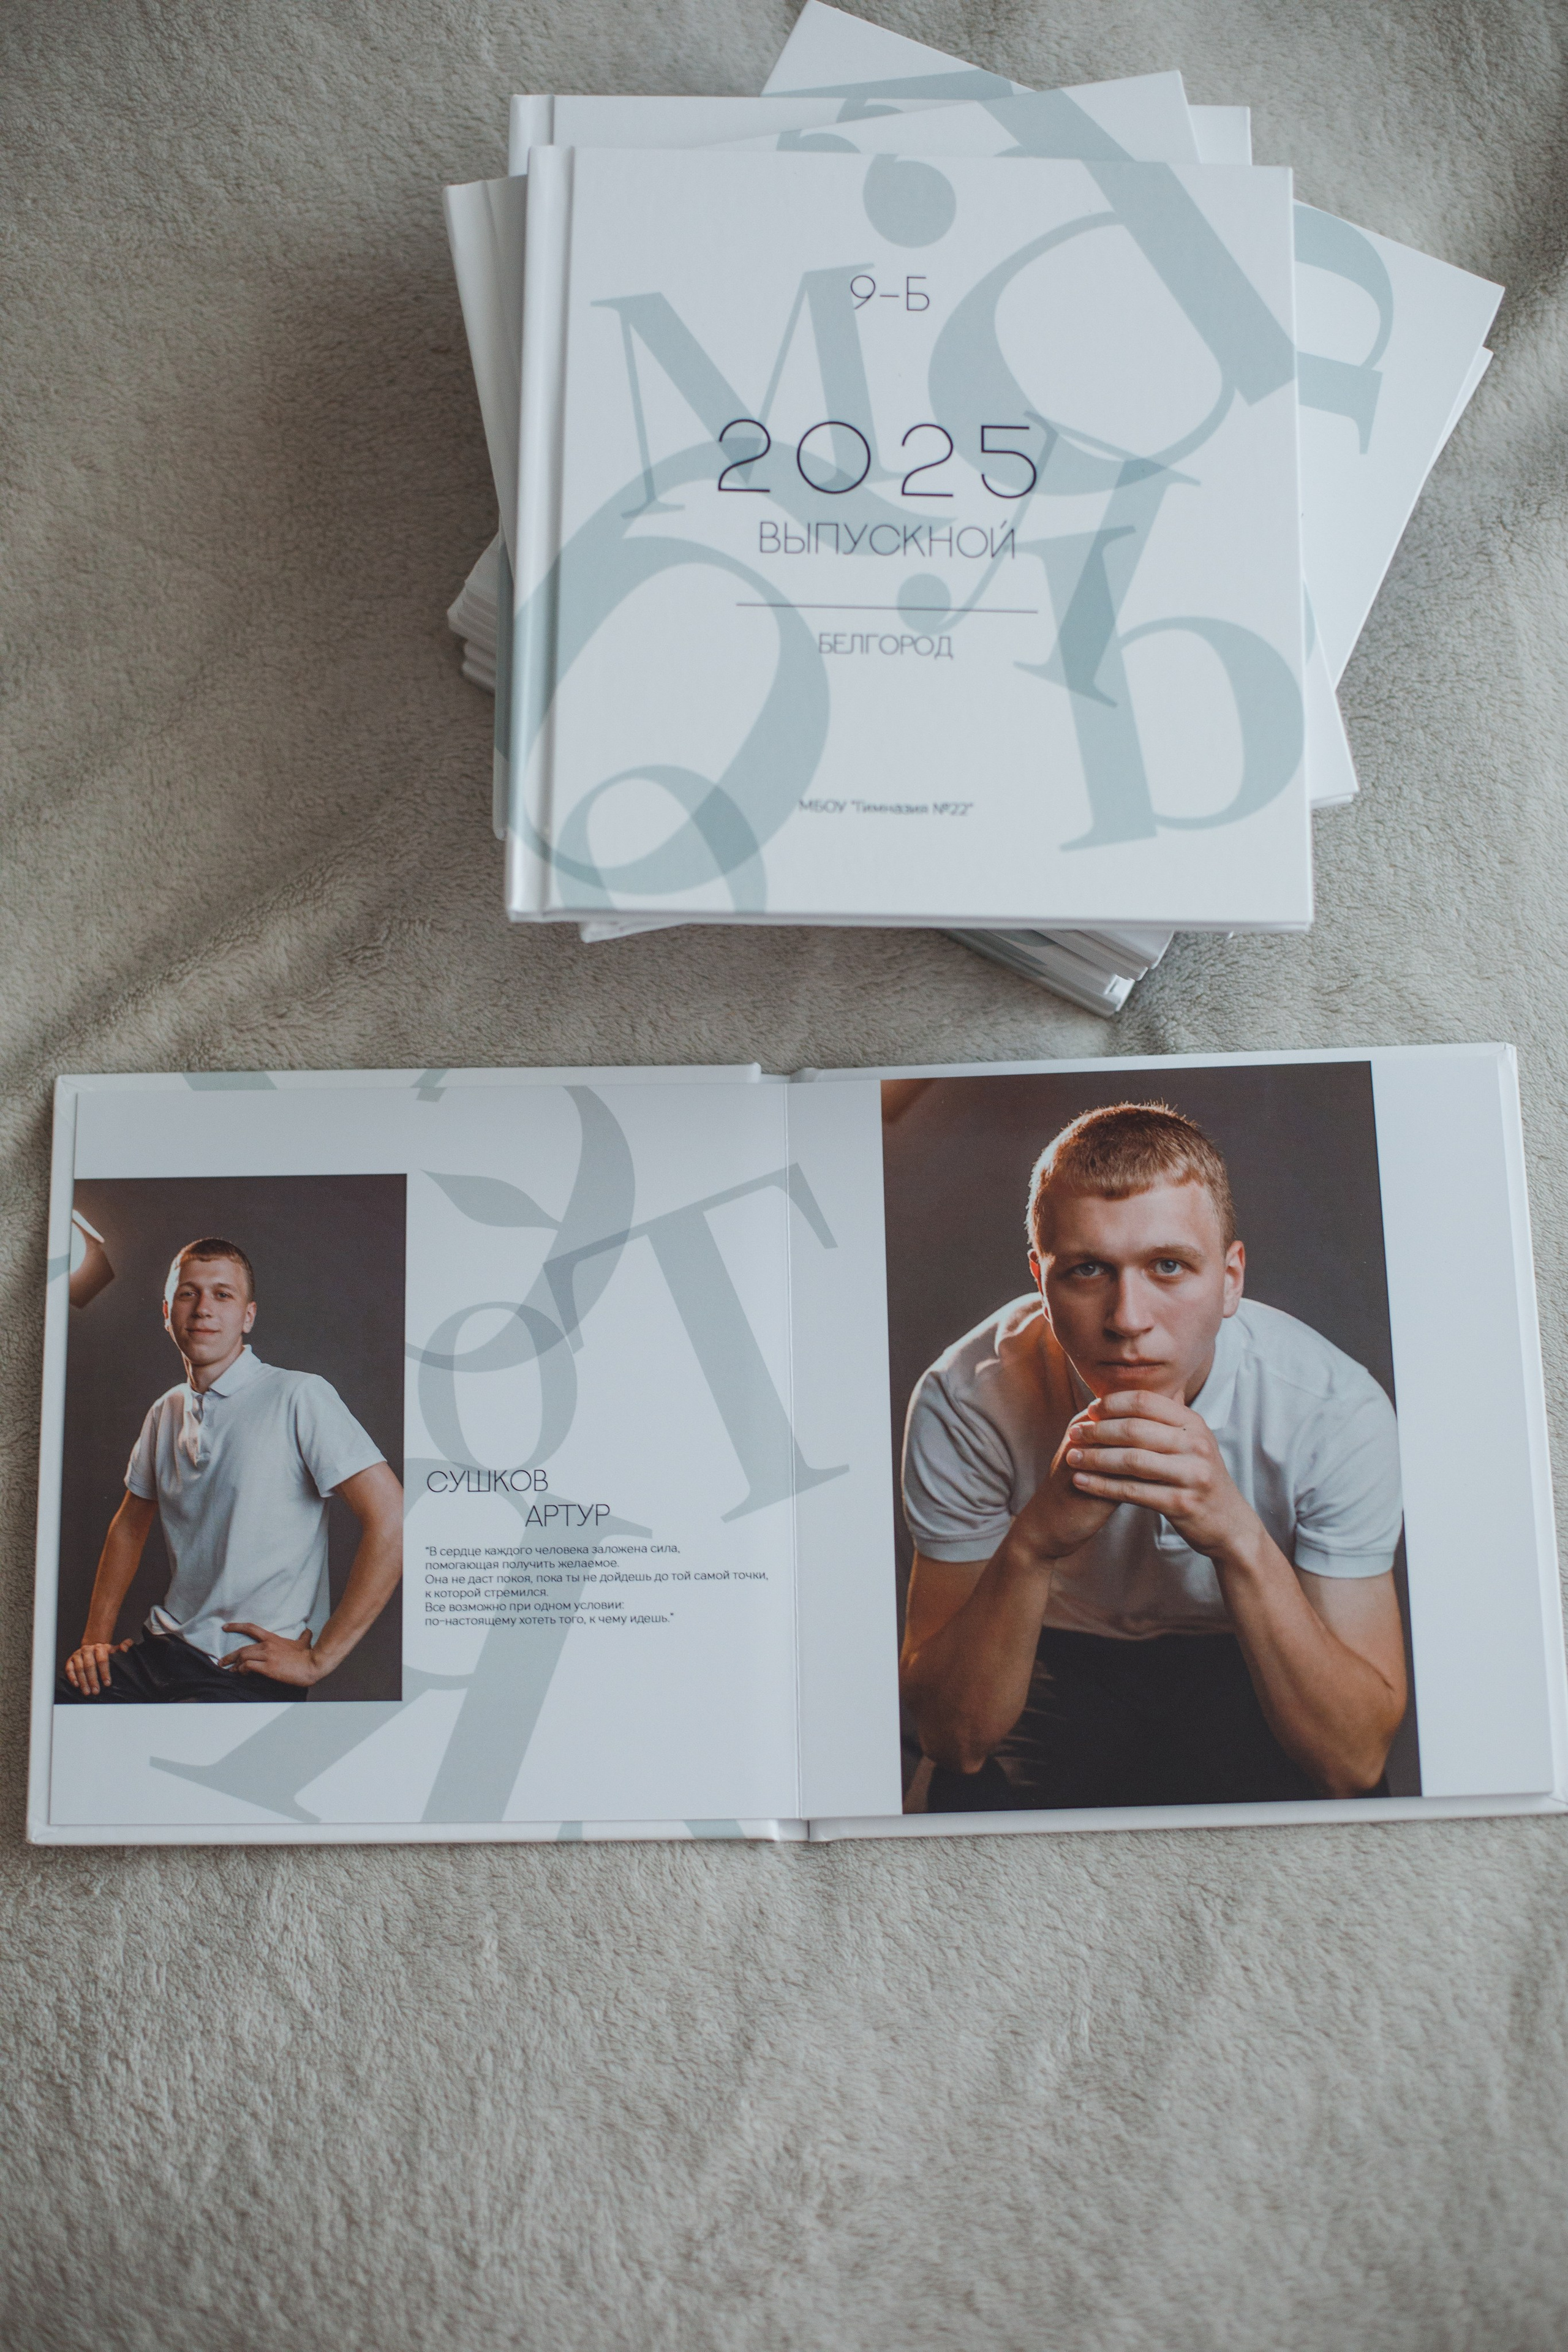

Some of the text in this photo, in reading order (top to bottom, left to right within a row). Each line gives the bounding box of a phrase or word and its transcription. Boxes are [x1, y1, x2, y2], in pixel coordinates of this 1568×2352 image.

[718, 418, 1037, 499] 2025
[760, 520, 1016, 559] ВЫПУСКНОЙ
[819, 633, 953, 660] БЕЛГОРОД
[427, 1469, 549, 1493] СУШКОВ
[525, 1504, 611, 1528] АРТУР
[440, 1548, 481, 1558] сердце
[484, 1547, 532, 1556] каждого
[592, 1545, 647, 1554] заложена
[650, 1545, 680, 1554] сила,
[425, 1560, 620, 1571] помогающая получить желаемое.
[425, 1574, 448, 1584] Она
[467, 1575, 494, 1585] даст
[497, 1575, 533, 1584] покоя,
[600, 1572, 652, 1583] дойдешь
[654, 1573, 669, 1582] до
[671, 1571, 691, 1581] той
[694, 1570, 730, 1580] самой
[733, 1572, 769, 1581] точки,
[434, 1588, 481, 1599] которой
[484, 1589, 549, 1599] стремился.
[425, 1601, 624, 1613] Все возможно при одном условии:
[425, 1617, 516, 1627] по-настоящему
[559, 1616, 586, 1624] того,
[598, 1615, 627, 1625] чему
